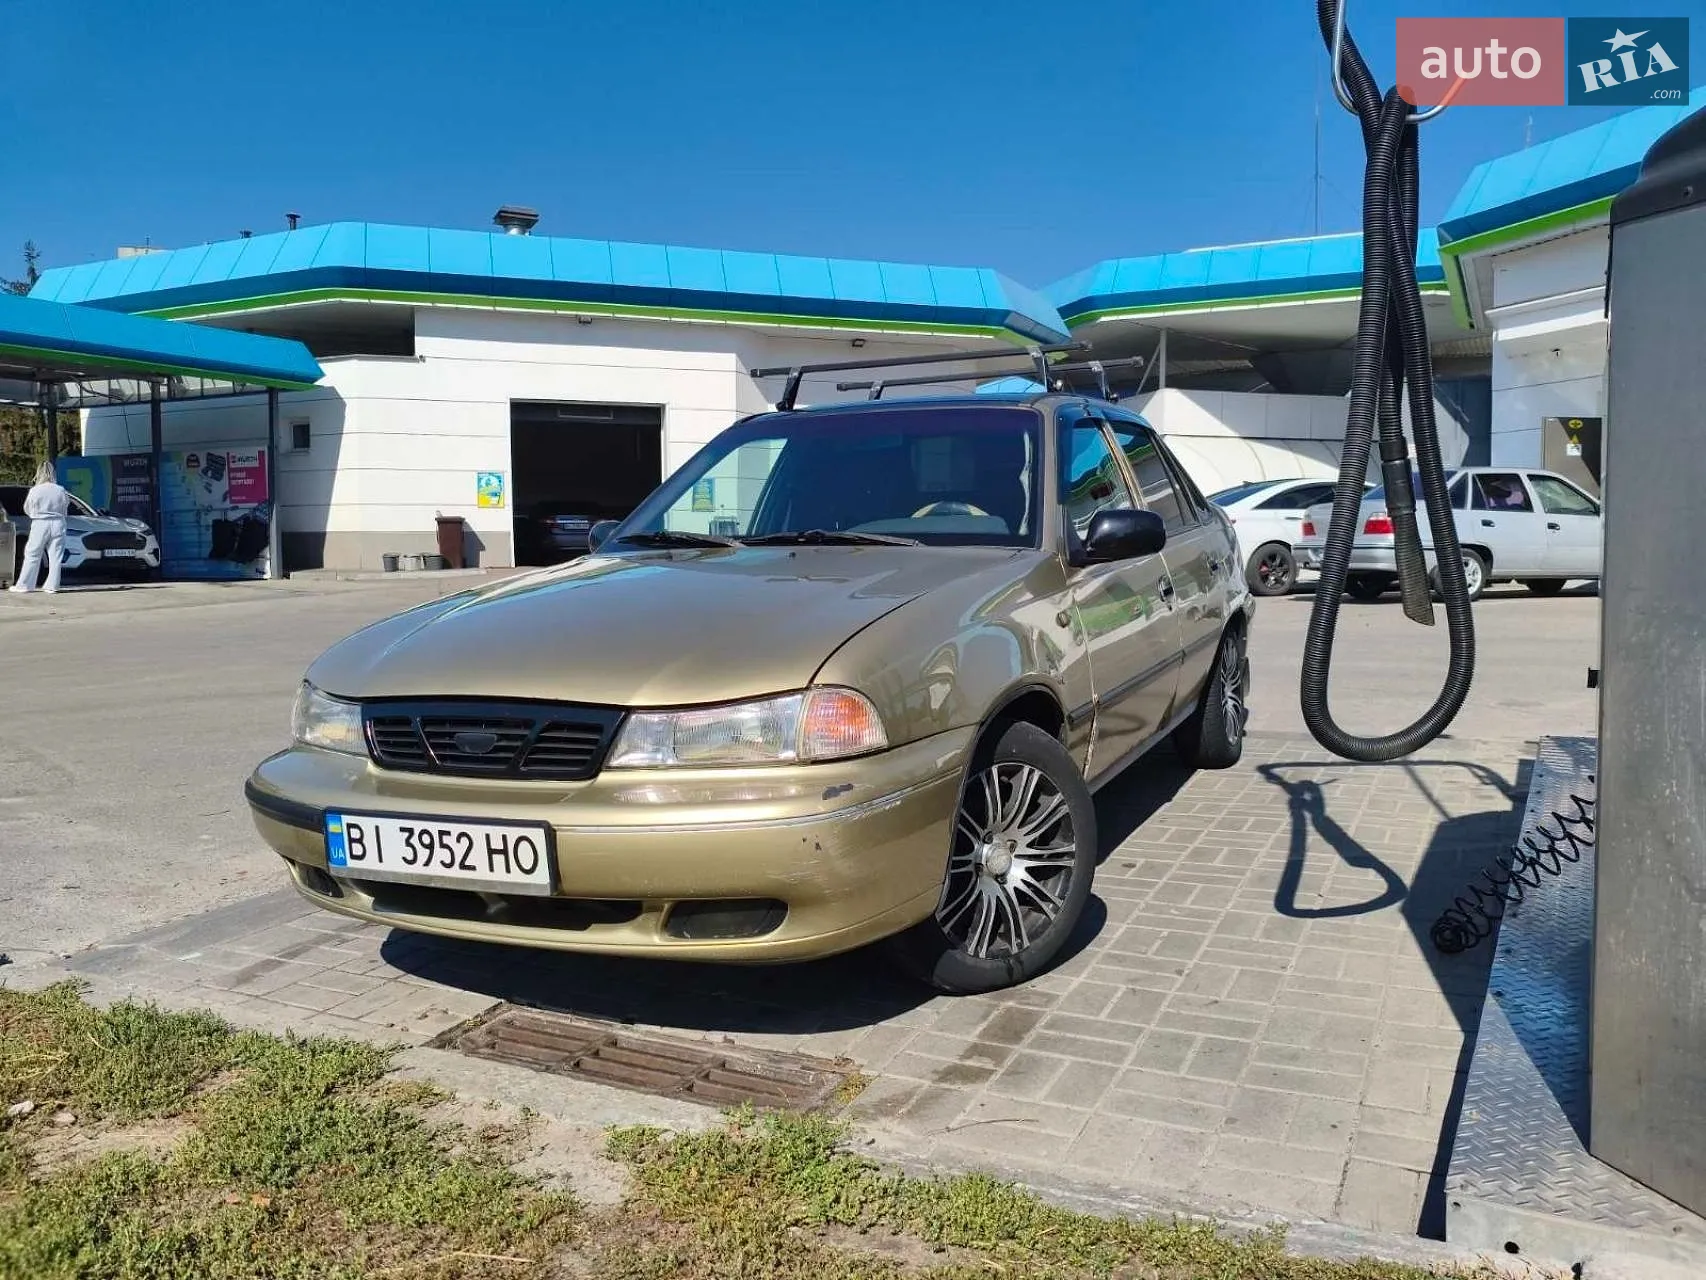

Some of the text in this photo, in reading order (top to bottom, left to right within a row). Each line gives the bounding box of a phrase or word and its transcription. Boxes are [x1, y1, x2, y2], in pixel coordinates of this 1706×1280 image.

[331, 848, 345, 859] UA
[346, 822, 539, 875] BI 3952 HO
